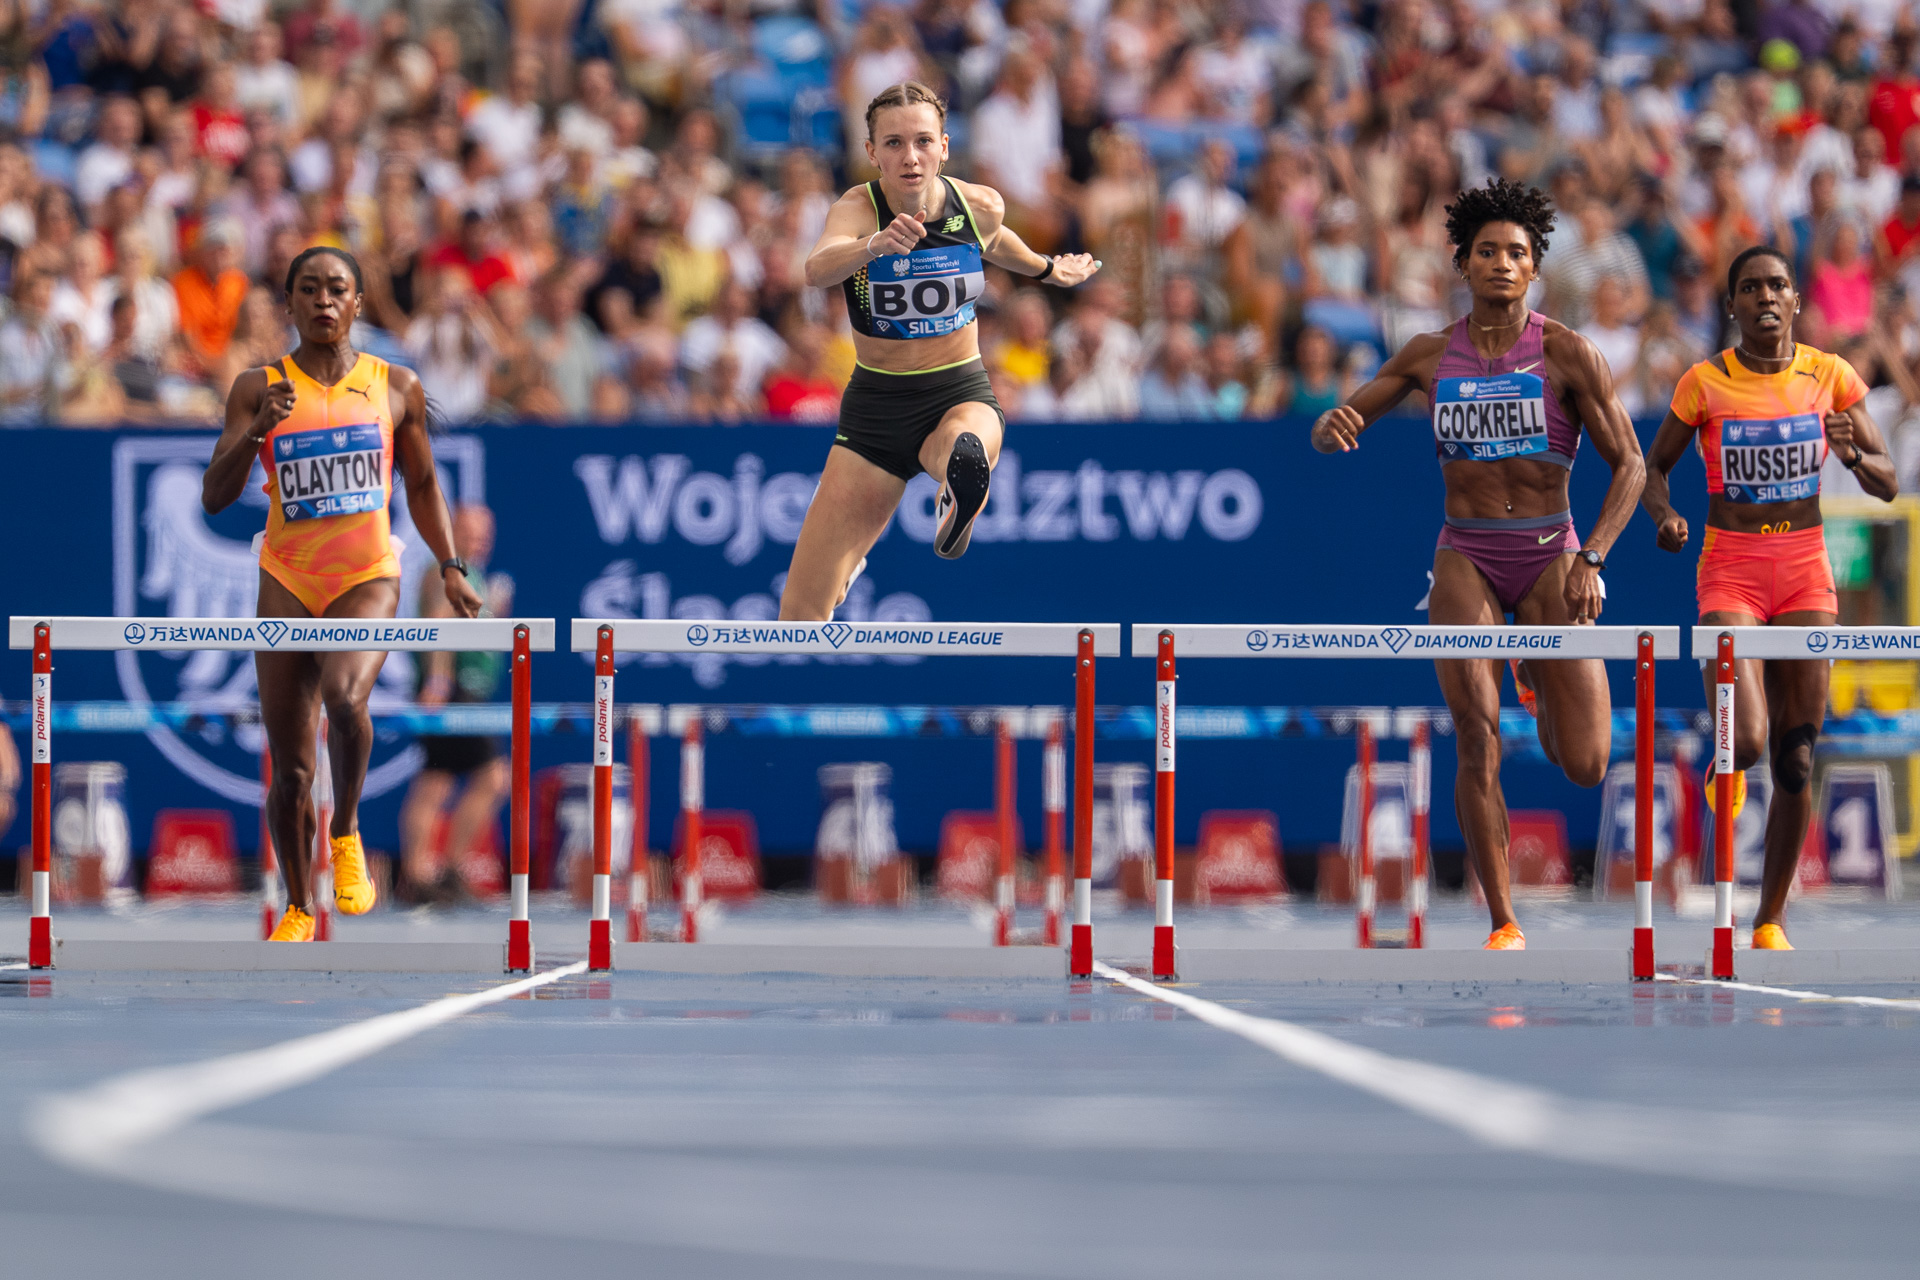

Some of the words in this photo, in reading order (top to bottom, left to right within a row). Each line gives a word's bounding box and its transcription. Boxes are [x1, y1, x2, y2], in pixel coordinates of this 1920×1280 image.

[912, 255, 947, 263] Ministerstwo
[935, 259, 960, 267] Turystyki
[873, 277, 978, 317] BOL
[909, 311, 965, 334] SILESIA
[1438, 401, 1544, 439] COCKRELL
[1473, 439, 1533, 458] SILESIA
[1725, 442, 1820, 481] RUSSELL
[280, 451, 381, 499] CLAYTON
[1757, 482, 1811, 500] SILESIA
[316, 493, 375, 514] SILESIA
[149, 626, 188, 642] 万达
[189, 627, 255, 641] WANDA
[290, 628, 369, 642] DIAMOND
[373, 628, 439, 642] LEAGUE
[713, 628, 751, 644] 万达
[753, 629, 820, 643] WANDA
[855, 630, 933, 645] DIAMOND
[937, 631, 1003, 645] LEAGUE
[1272, 633, 1310, 649] 万达
[1312, 634, 1379, 648] WANDA
[1414, 634, 1493, 648] DIAMOND
[1497, 635, 1562, 648] LEAGUE
[1832, 634, 1870, 649] 万达
[36, 695, 47, 740] polanik
[598, 698, 608, 743] polanik
[1160, 703, 1171, 748] polanik
[1719, 705, 1730, 751] polanik
[1829, 797, 1880, 879] 1
